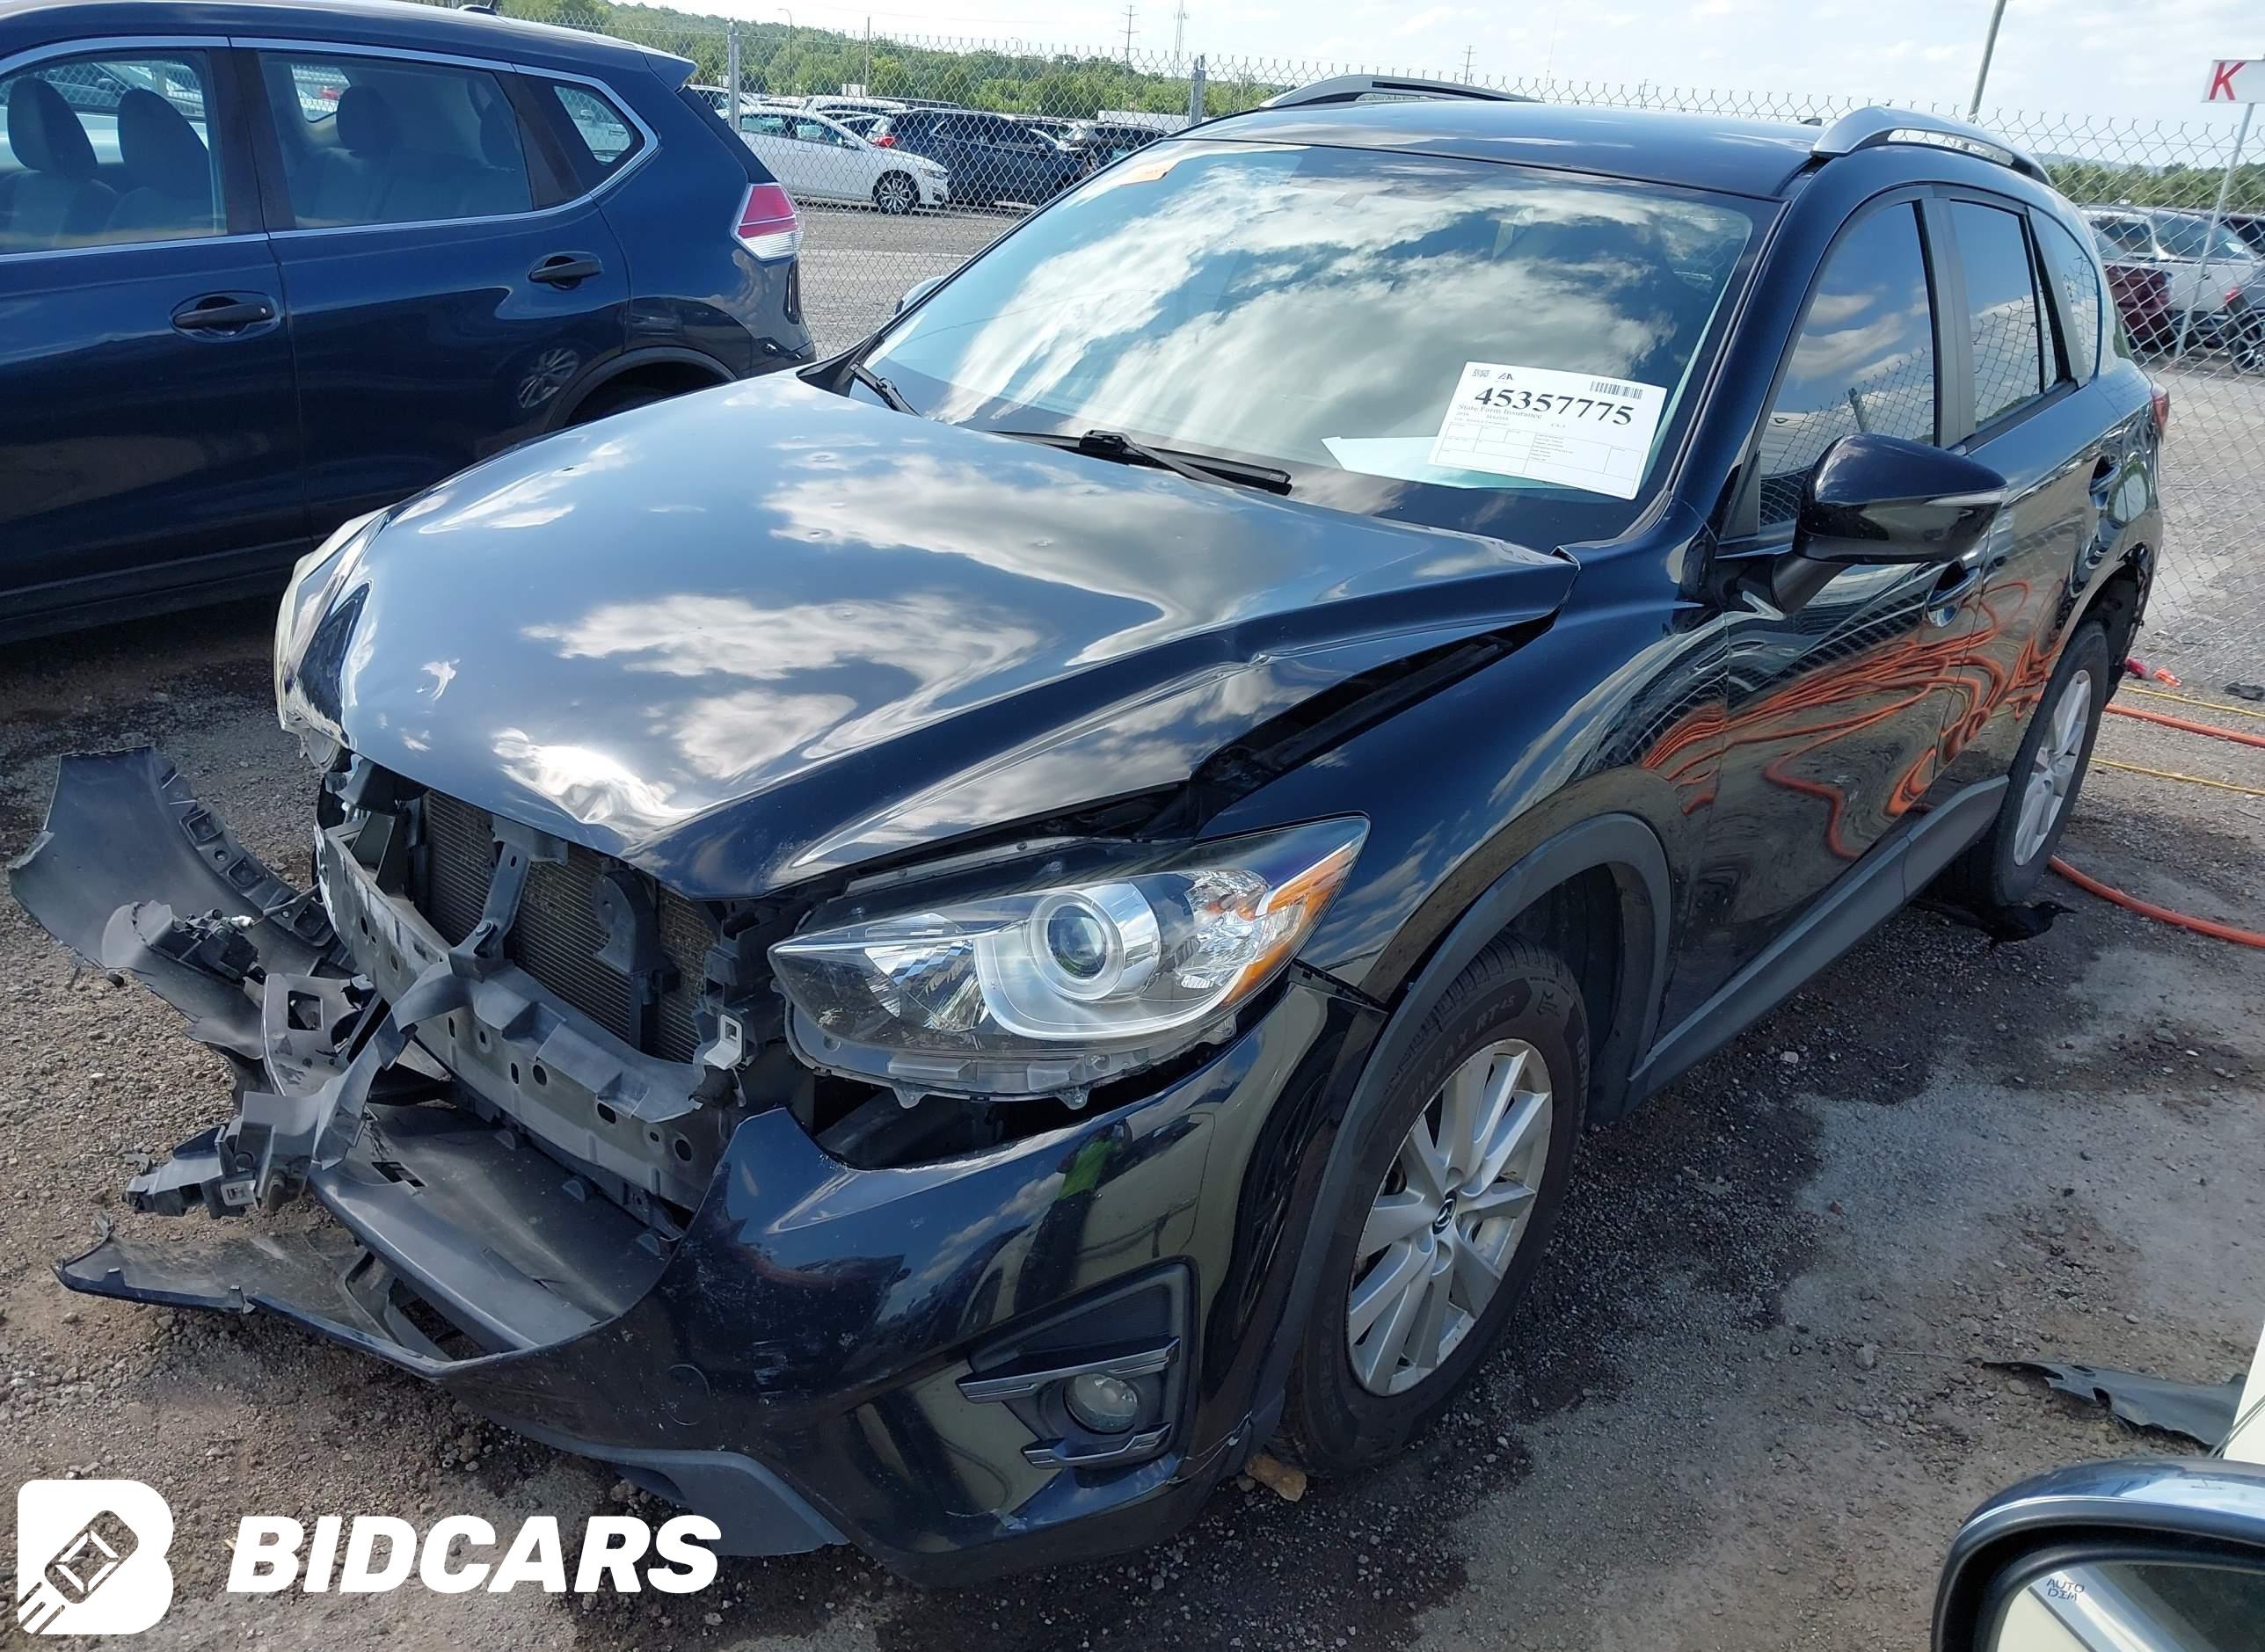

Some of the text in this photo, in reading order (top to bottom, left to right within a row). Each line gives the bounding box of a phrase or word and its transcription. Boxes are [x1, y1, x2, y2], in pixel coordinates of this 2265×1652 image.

[2208, 61, 2247, 101] K
[1475, 387, 1635, 426] 45357775
[1504, 408, 1543, 419] Insurance
[2047, 1578, 2085, 1593] AUTO
[2048, 1588, 2077, 1601] DIM
